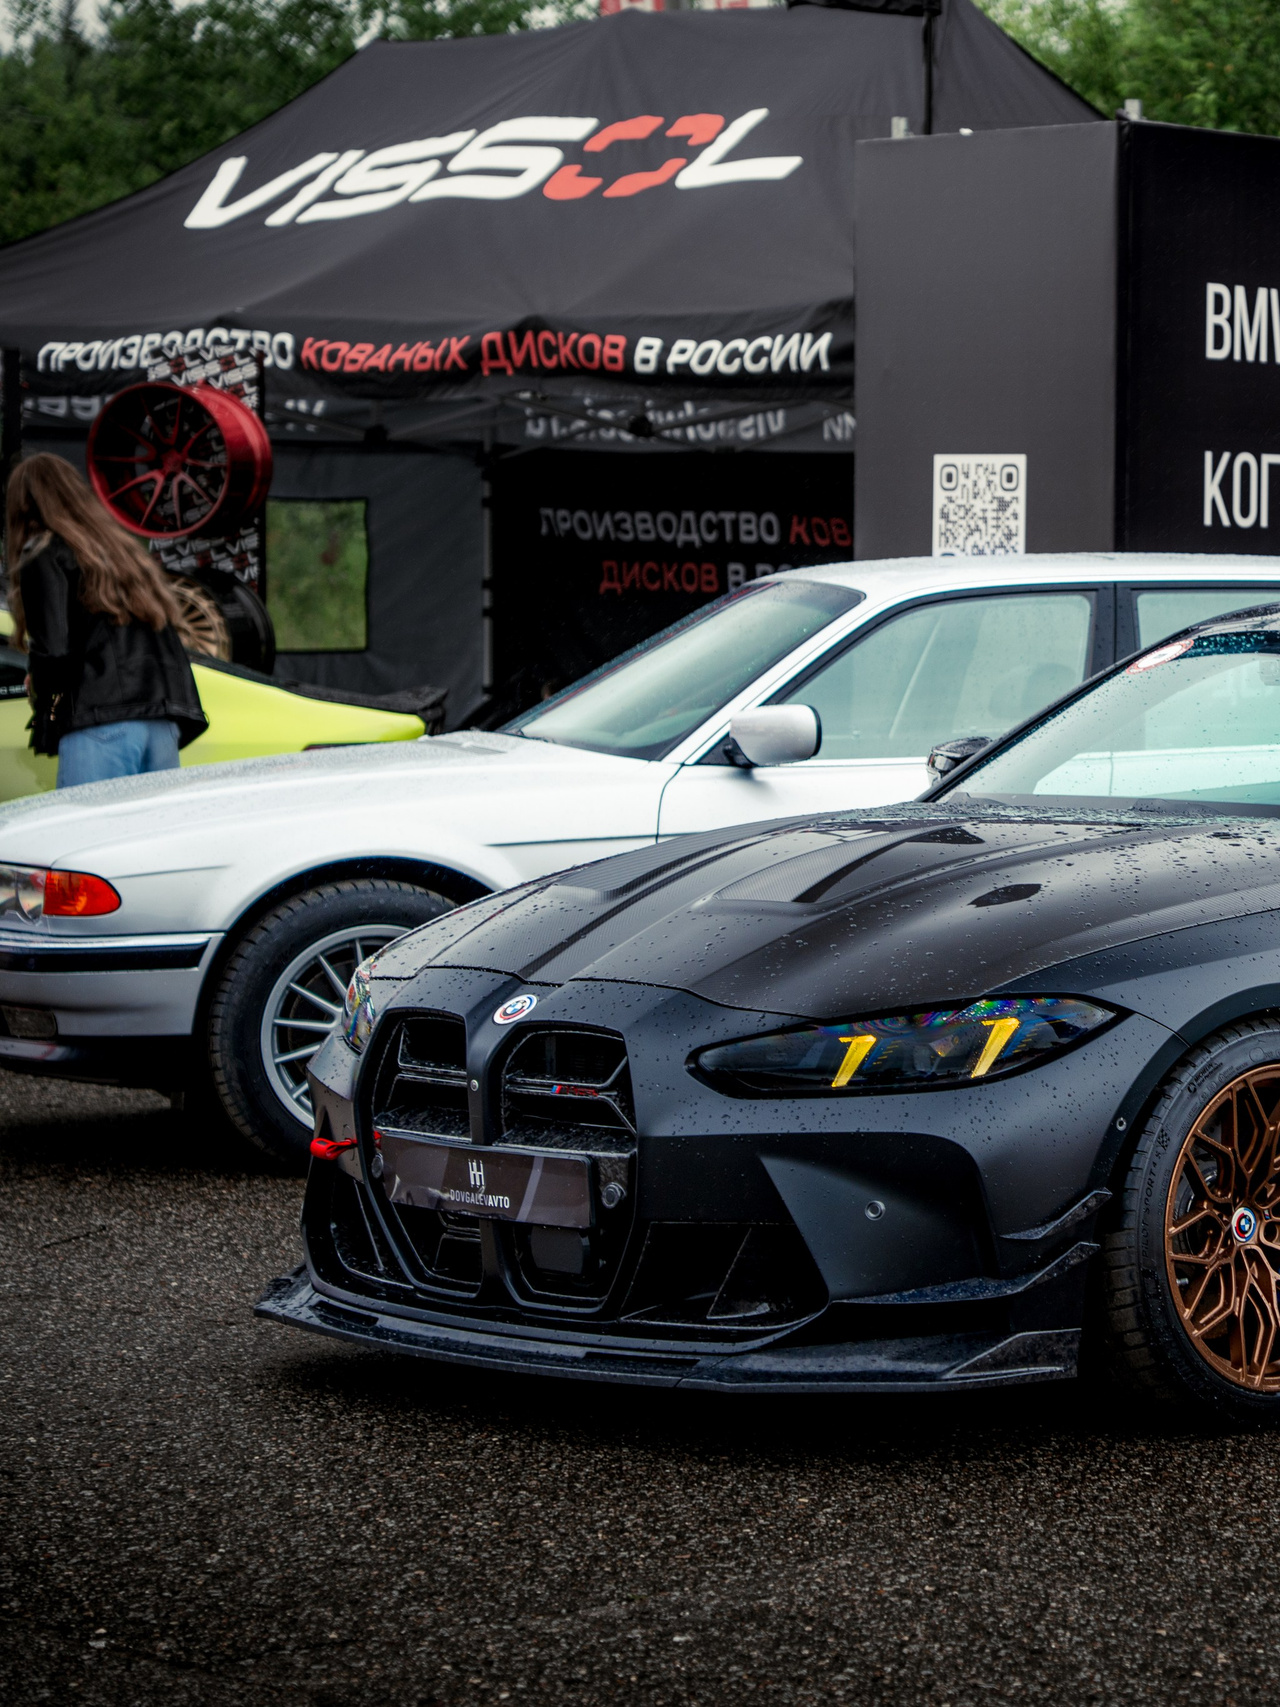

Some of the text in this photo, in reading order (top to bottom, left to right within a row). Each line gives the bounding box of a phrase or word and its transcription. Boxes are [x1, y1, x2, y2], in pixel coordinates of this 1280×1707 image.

[184, 108, 803, 228] VISSOL
[301, 336, 471, 372] КОВАНЫХ
[480, 330, 627, 376] ДИСКОВ
[634, 336, 664, 374] В
[666, 332, 834, 375] РОССИИ
[540, 507, 782, 549] ПРОИЗВОДСТВО
[600, 560, 720, 596] ДИСКОВ
